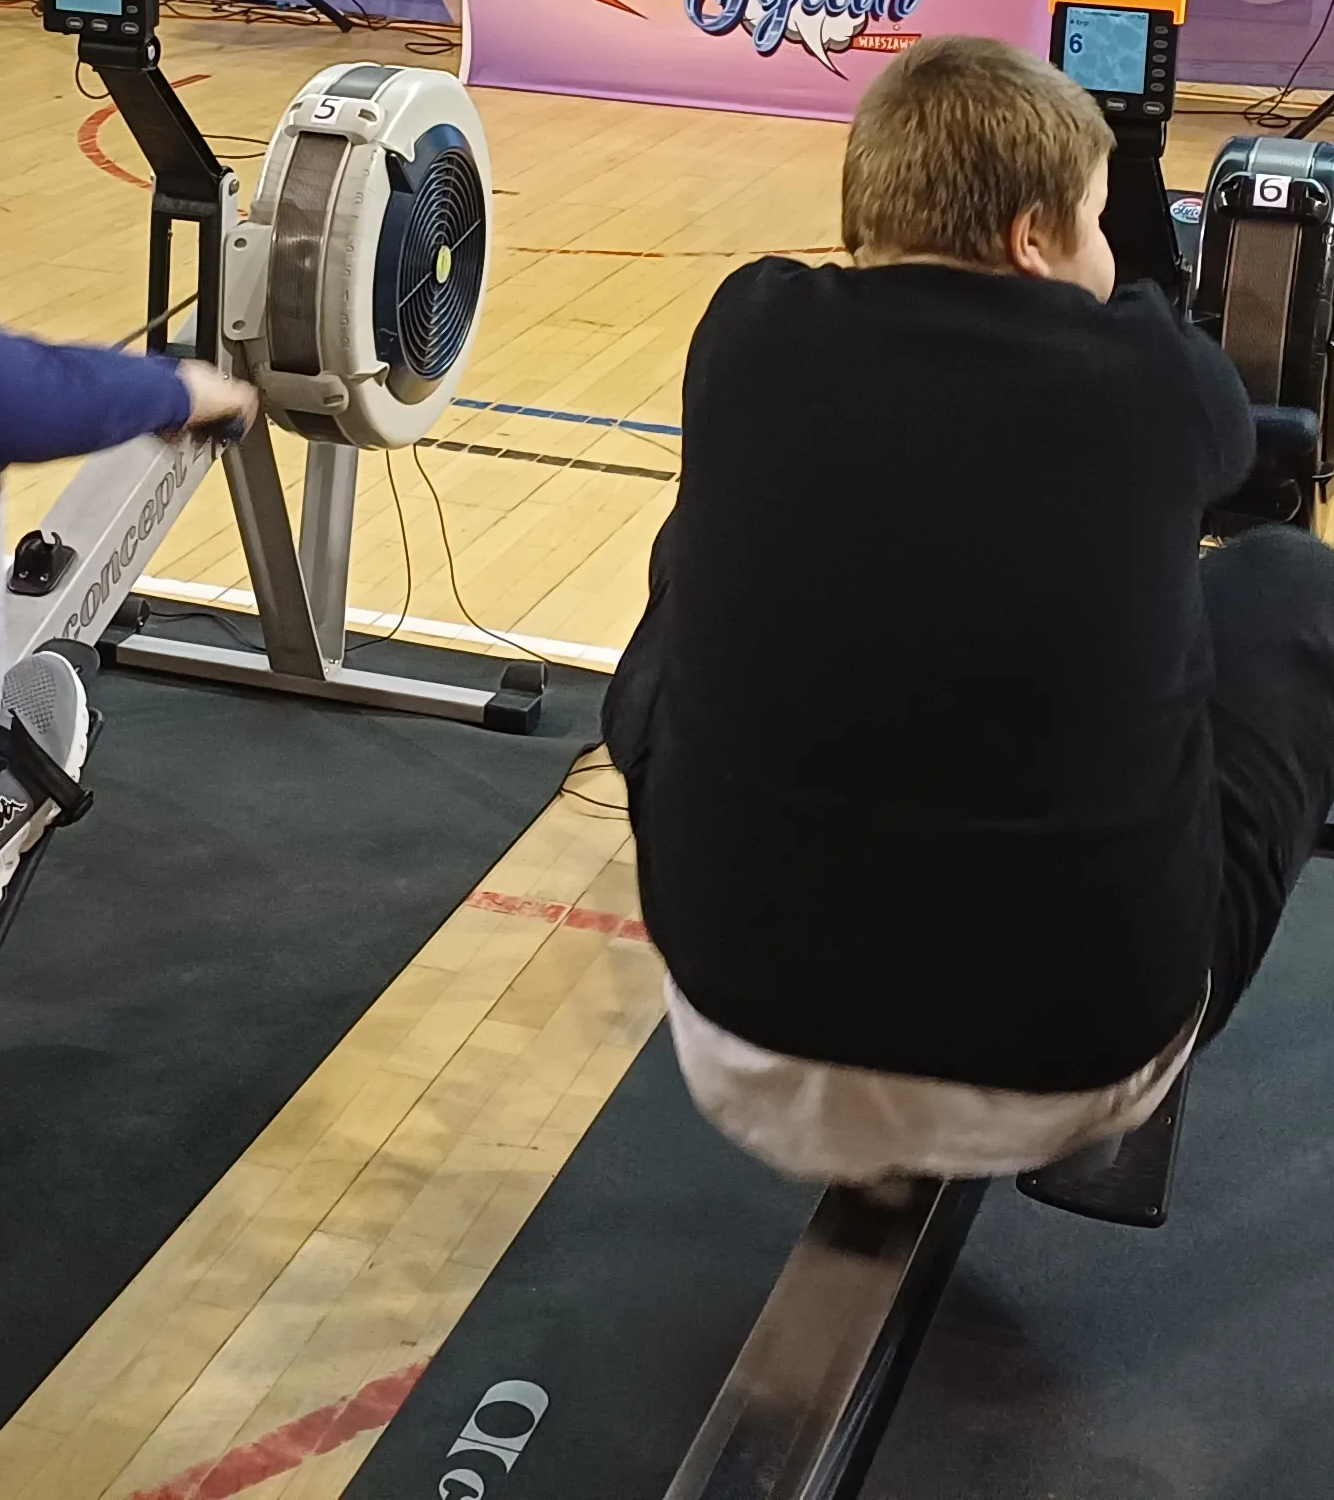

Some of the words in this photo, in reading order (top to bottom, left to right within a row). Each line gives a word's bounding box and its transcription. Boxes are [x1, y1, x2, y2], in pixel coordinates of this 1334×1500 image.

[1069, 32, 1083, 54] 6
[312, 97, 337, 120] 5
[1258, 177, 1284, 203] 6
[62, 451, 188, 640] concept
